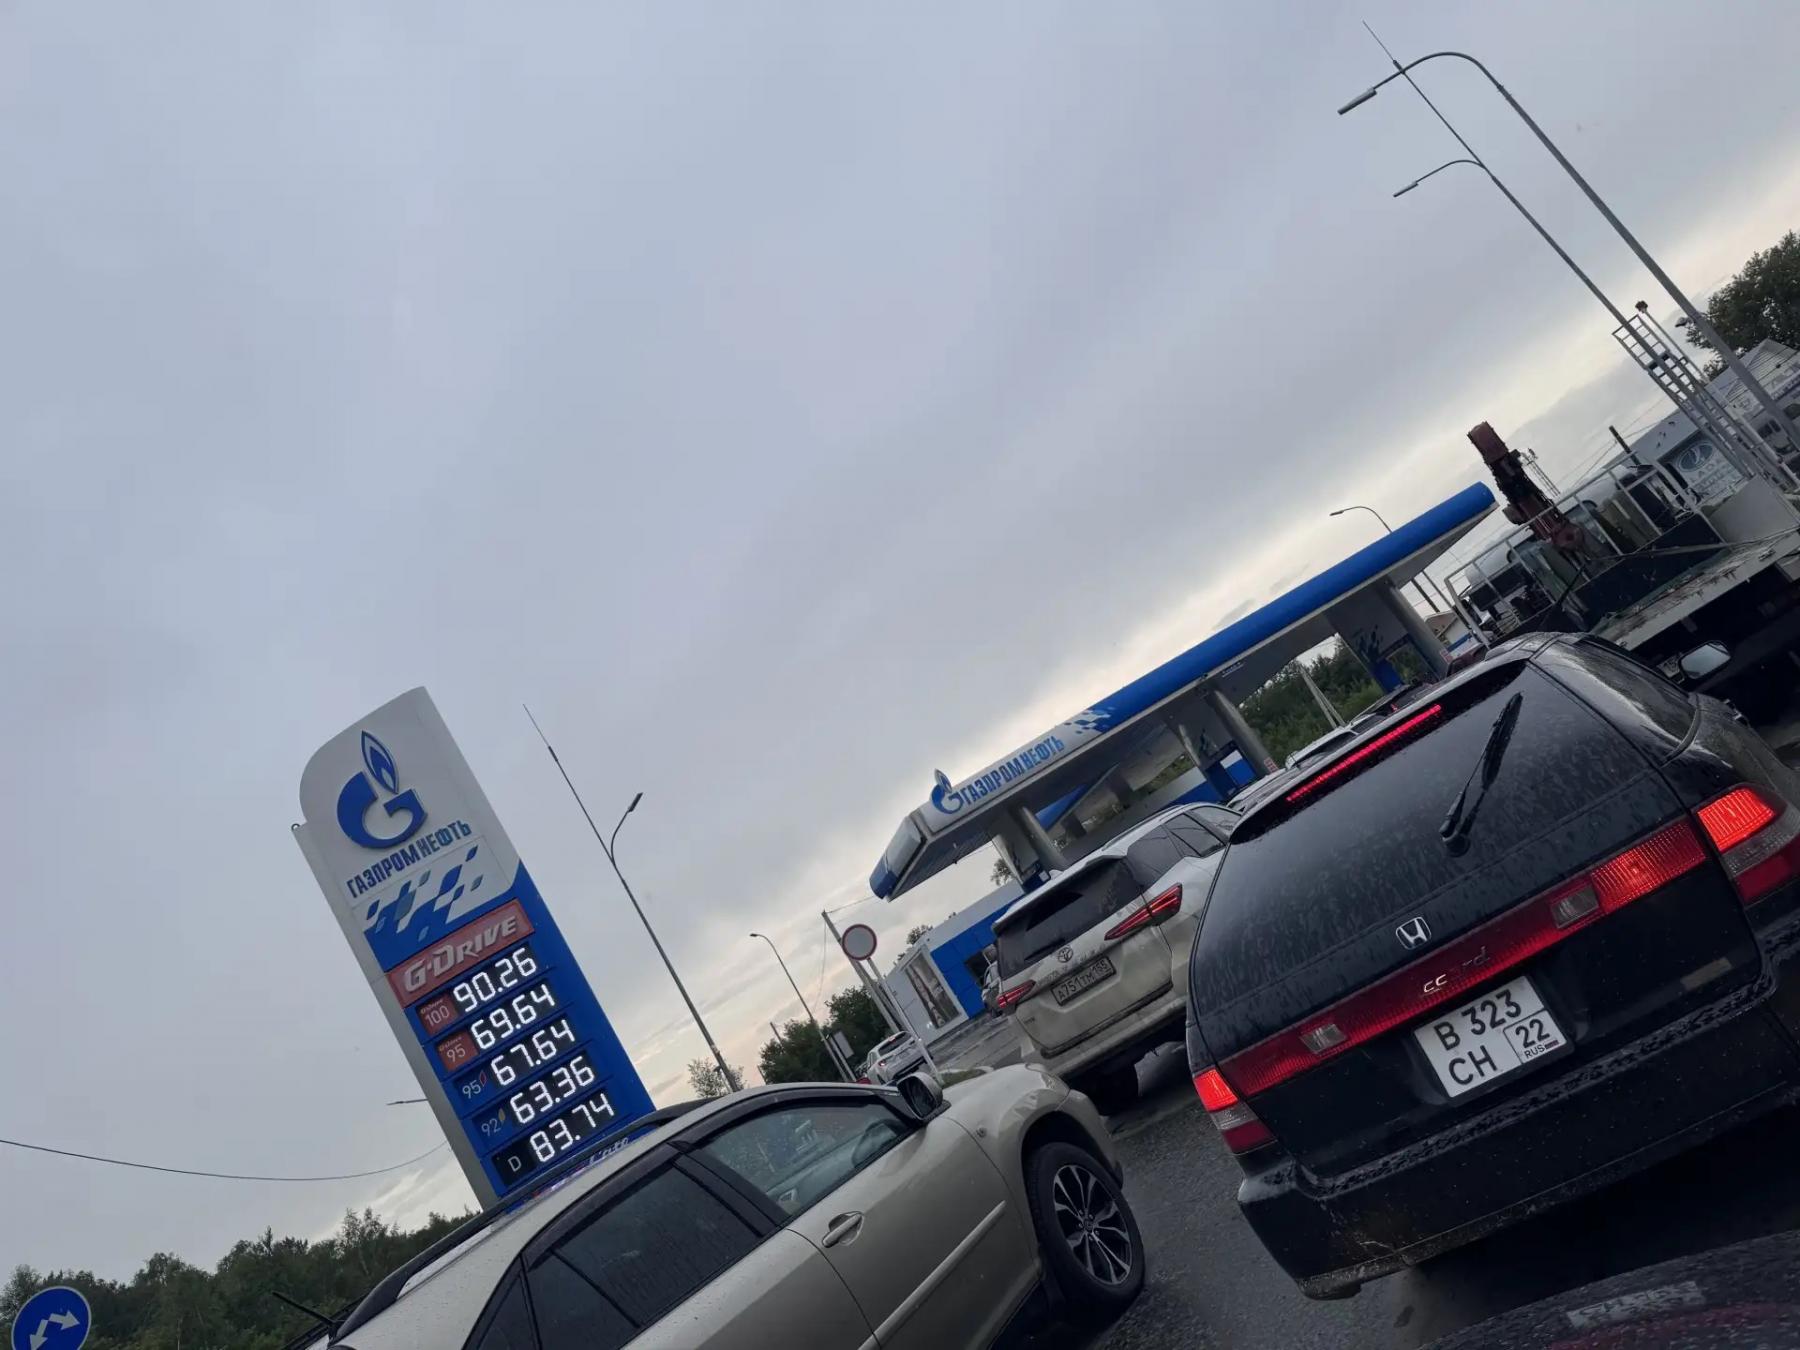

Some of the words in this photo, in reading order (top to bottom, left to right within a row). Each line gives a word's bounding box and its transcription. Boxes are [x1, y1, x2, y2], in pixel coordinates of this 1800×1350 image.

[961, 735, 1065, 805] ГАЗПРОМНЕФТЬ
[346, 820, 472, 898] ГАЗПРОМНЕФТЬ
[425, 1005, 450, 1027] 100
[453, 947, 537, 1012] 90.26
[446, 1043, 466, 1062] 95
[471, 984, 555, 1050] 69.64
[1433, 1021, 1461, 1051] В
[1461, 989, 1521, 1036] 323
[462, 1080, 481, 1099] 95
[491, 1019, 576, 1085] 67.64
[1449, 1044, 1498, 1086] СН
[1515, 1018, 1551, 1049] 22
[1523, 1044, 1546, 1060] RUS
[481, 1118, 501, 1137] 92
[510, 1055, 595, 1124] 63.36
[507, 1155, 522, 1172] D
[529, 1093, 615, 1162] 83.74
